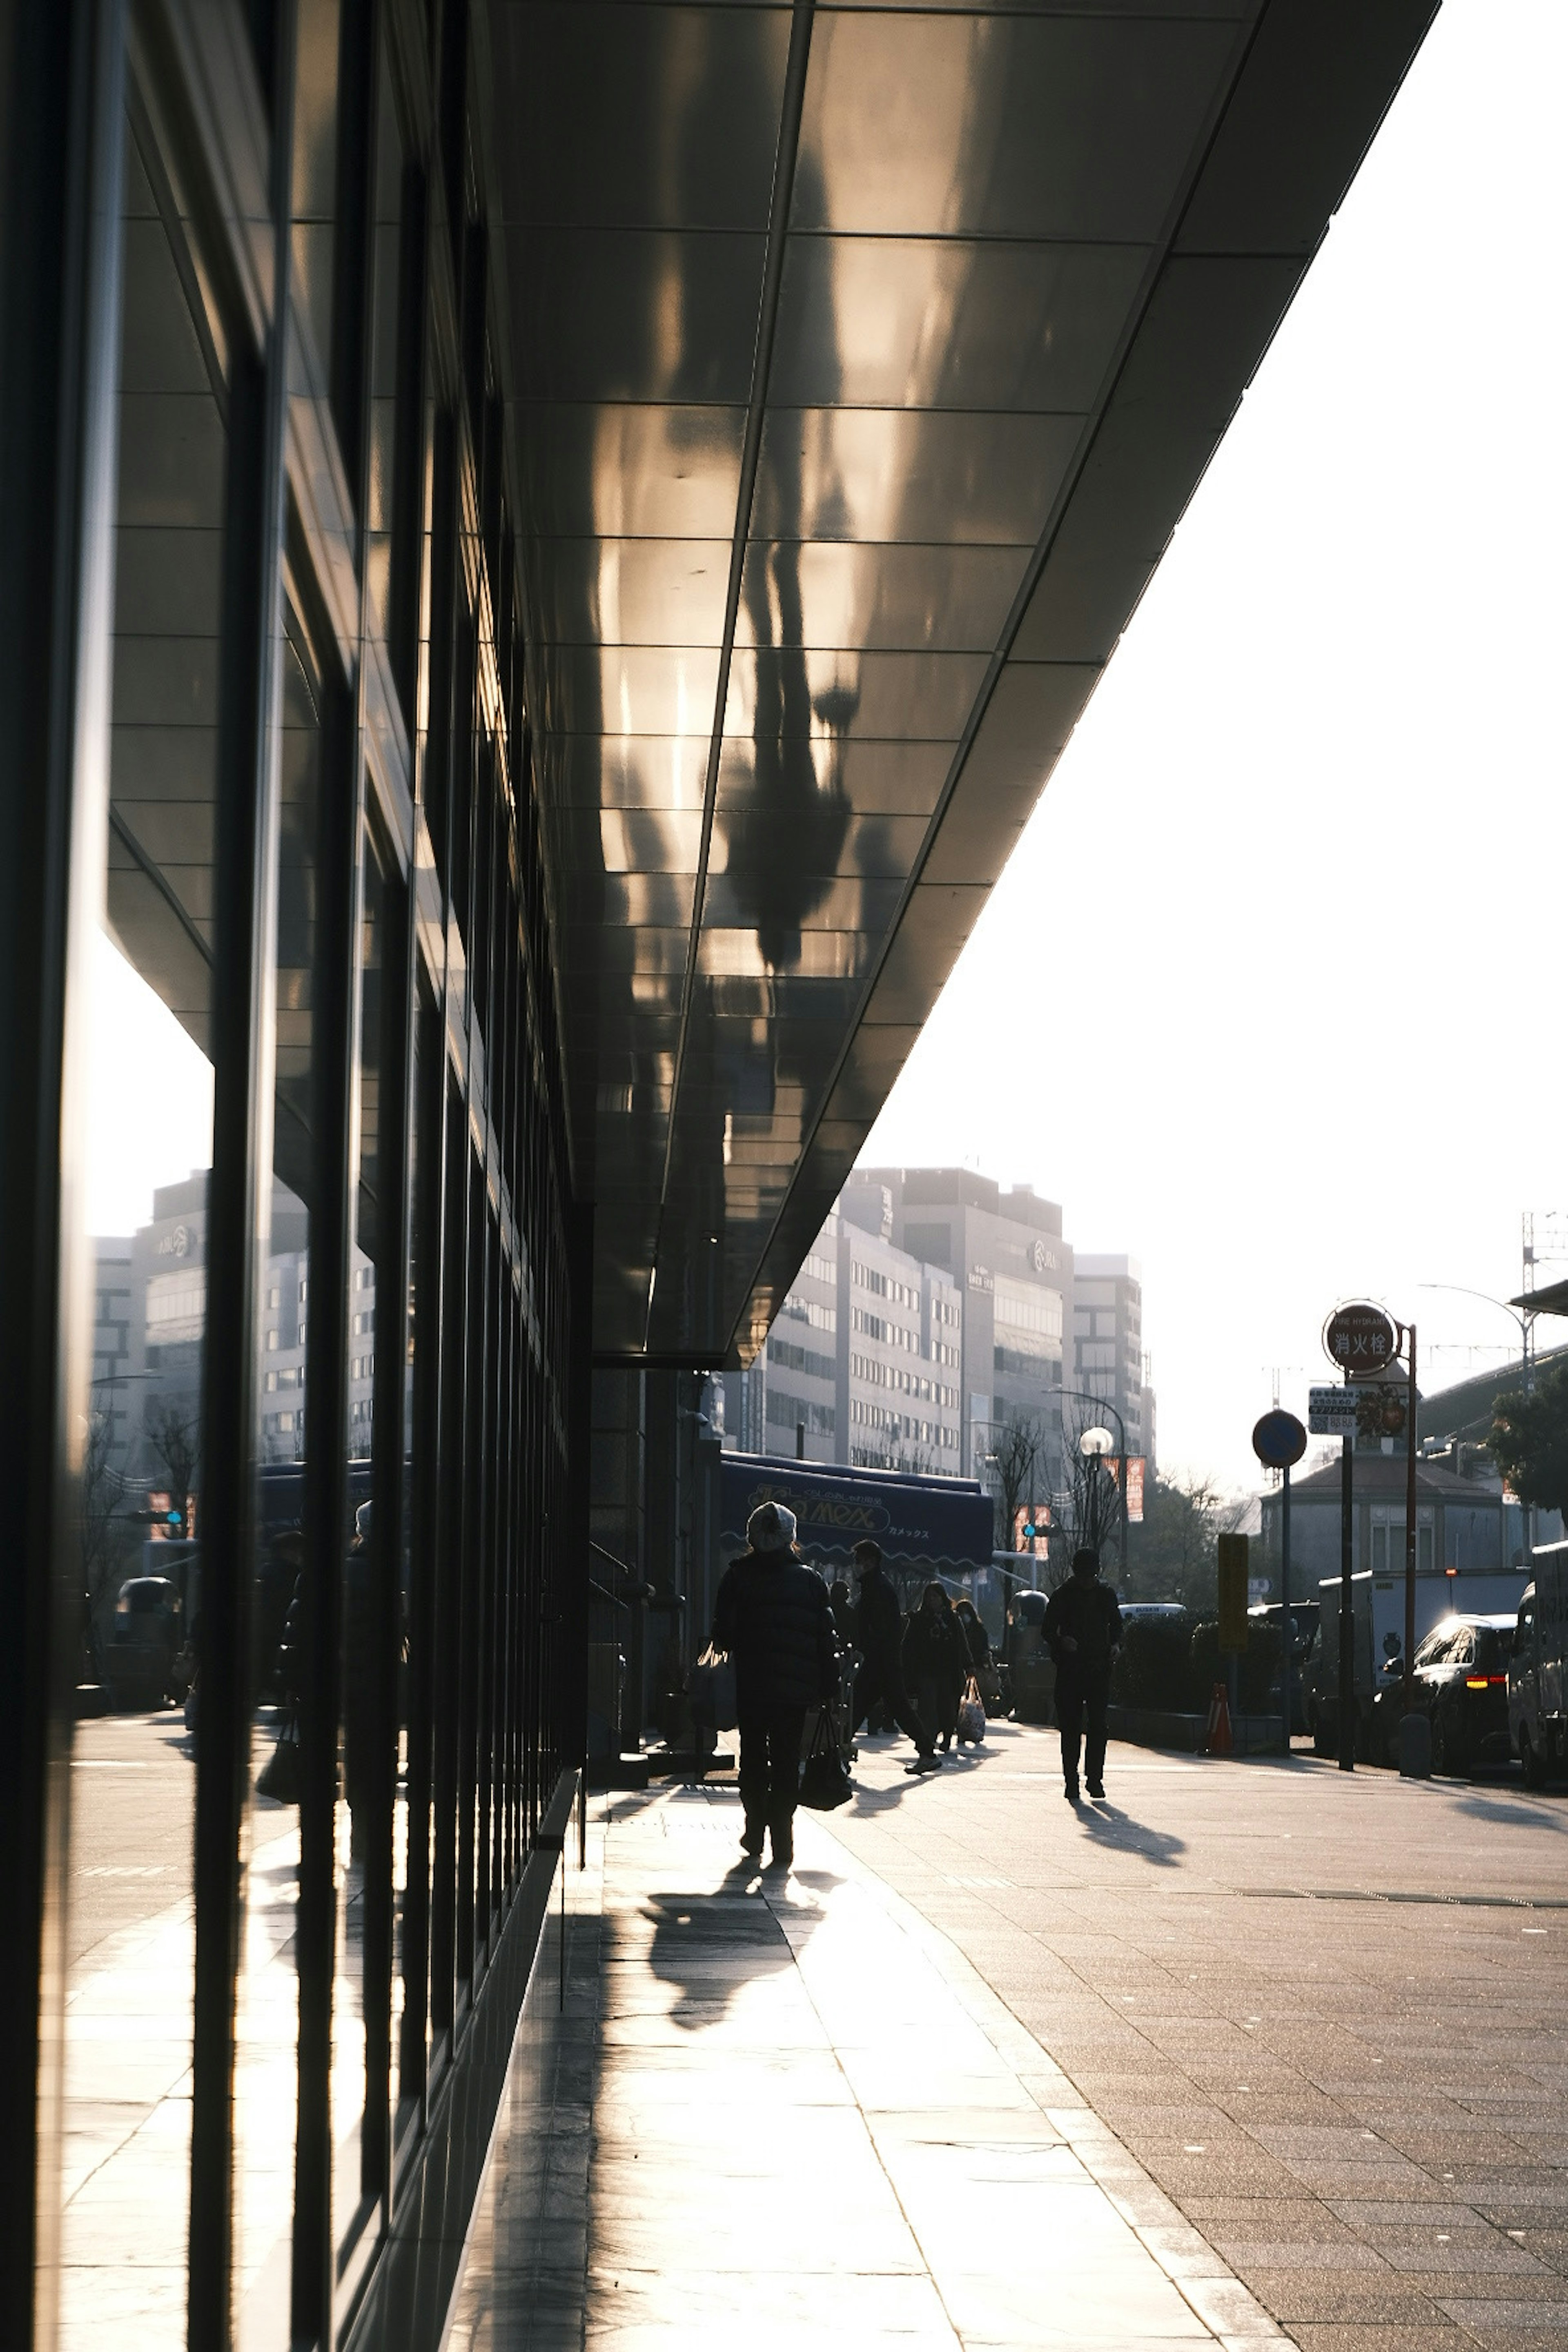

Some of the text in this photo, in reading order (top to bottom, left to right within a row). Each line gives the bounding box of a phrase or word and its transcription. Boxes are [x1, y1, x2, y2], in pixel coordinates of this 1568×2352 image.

[1335, 1332, 1386, 1355] 消火栓
[889, 1526, 929, 1539] カメックス
